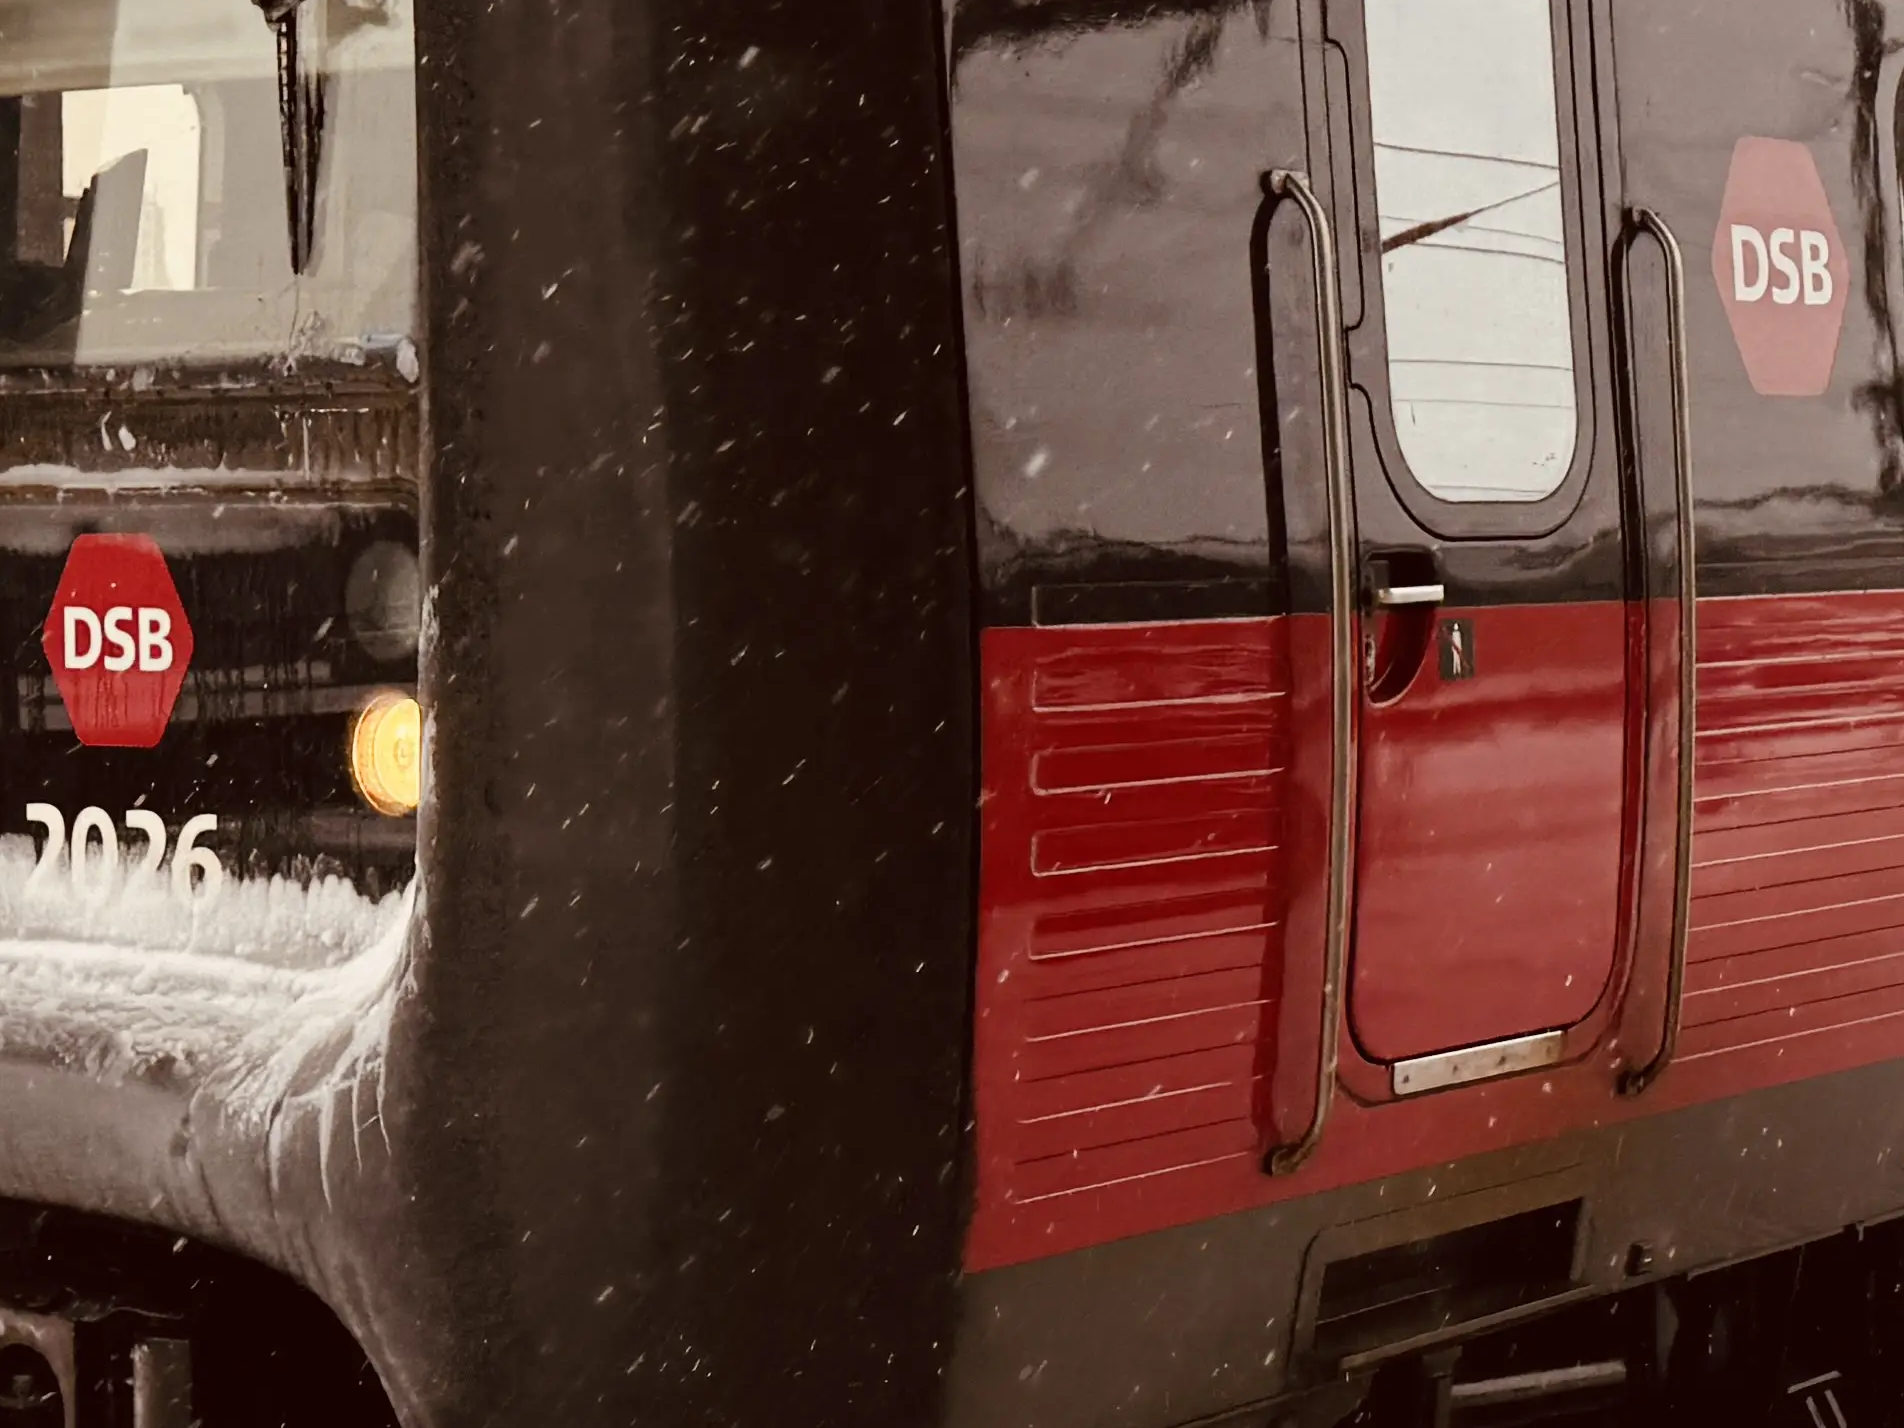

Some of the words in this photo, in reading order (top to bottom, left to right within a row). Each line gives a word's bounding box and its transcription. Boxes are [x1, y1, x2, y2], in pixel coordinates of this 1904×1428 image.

[1730, 223, 1834, 306] DSB
[62, 605, 174, 673] DSB
[25, 802, 223, 904] 2026
